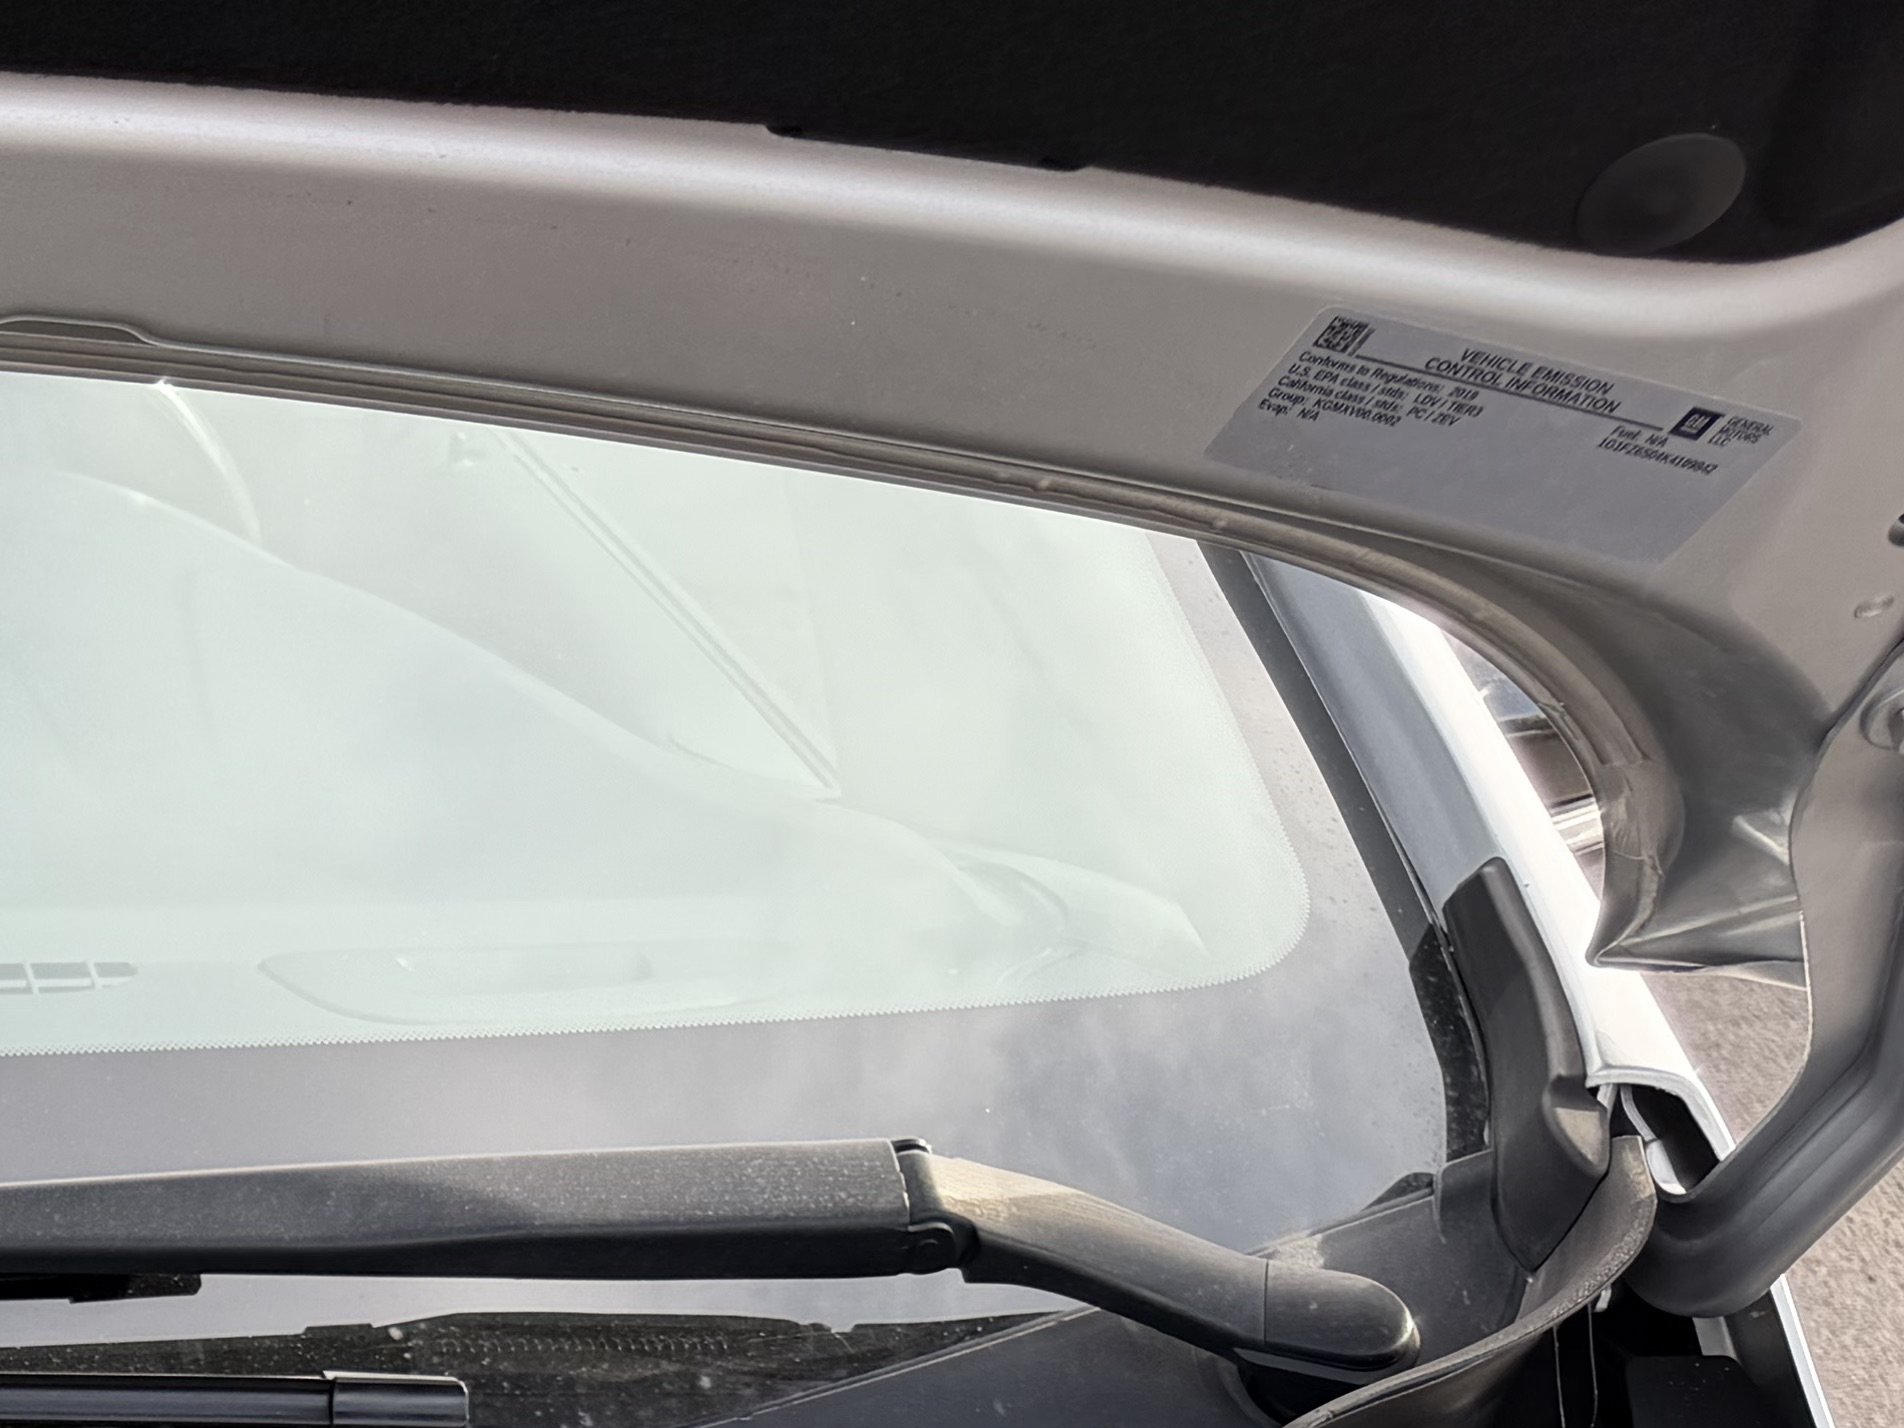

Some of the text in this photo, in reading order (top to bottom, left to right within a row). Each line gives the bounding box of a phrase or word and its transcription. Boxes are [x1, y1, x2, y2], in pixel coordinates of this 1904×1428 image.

[1288, 363, 1311, 379] U.S.
[1313, 370, 1339, 385] EPA
[1340, 376, 1371, 392] class
[1413, 392, 1441, 408] LDV
[1299, 351, 1446, 394] Conforms to Regulations:
[1425, 357, 1621, 414] CONTROL INFORMATION
[1461, 348, 1614, 395] VEHICLE EMISSION
[1257, 399, 1321, 422] Evap: N/A
[1268, 387, 1309, 407] Group:
[1278, 376, 1334, 399] California
[1335, 389, 1368, 406] class
[1407, 406, 1424, 420] PC
[1431, 413, 1463, 427] ZEV
[1707, 435, 1732, 447] LLC
[1717, 426, 1763, 444] MOTORS
[1727, 416, 1774, 436] GENERAL
